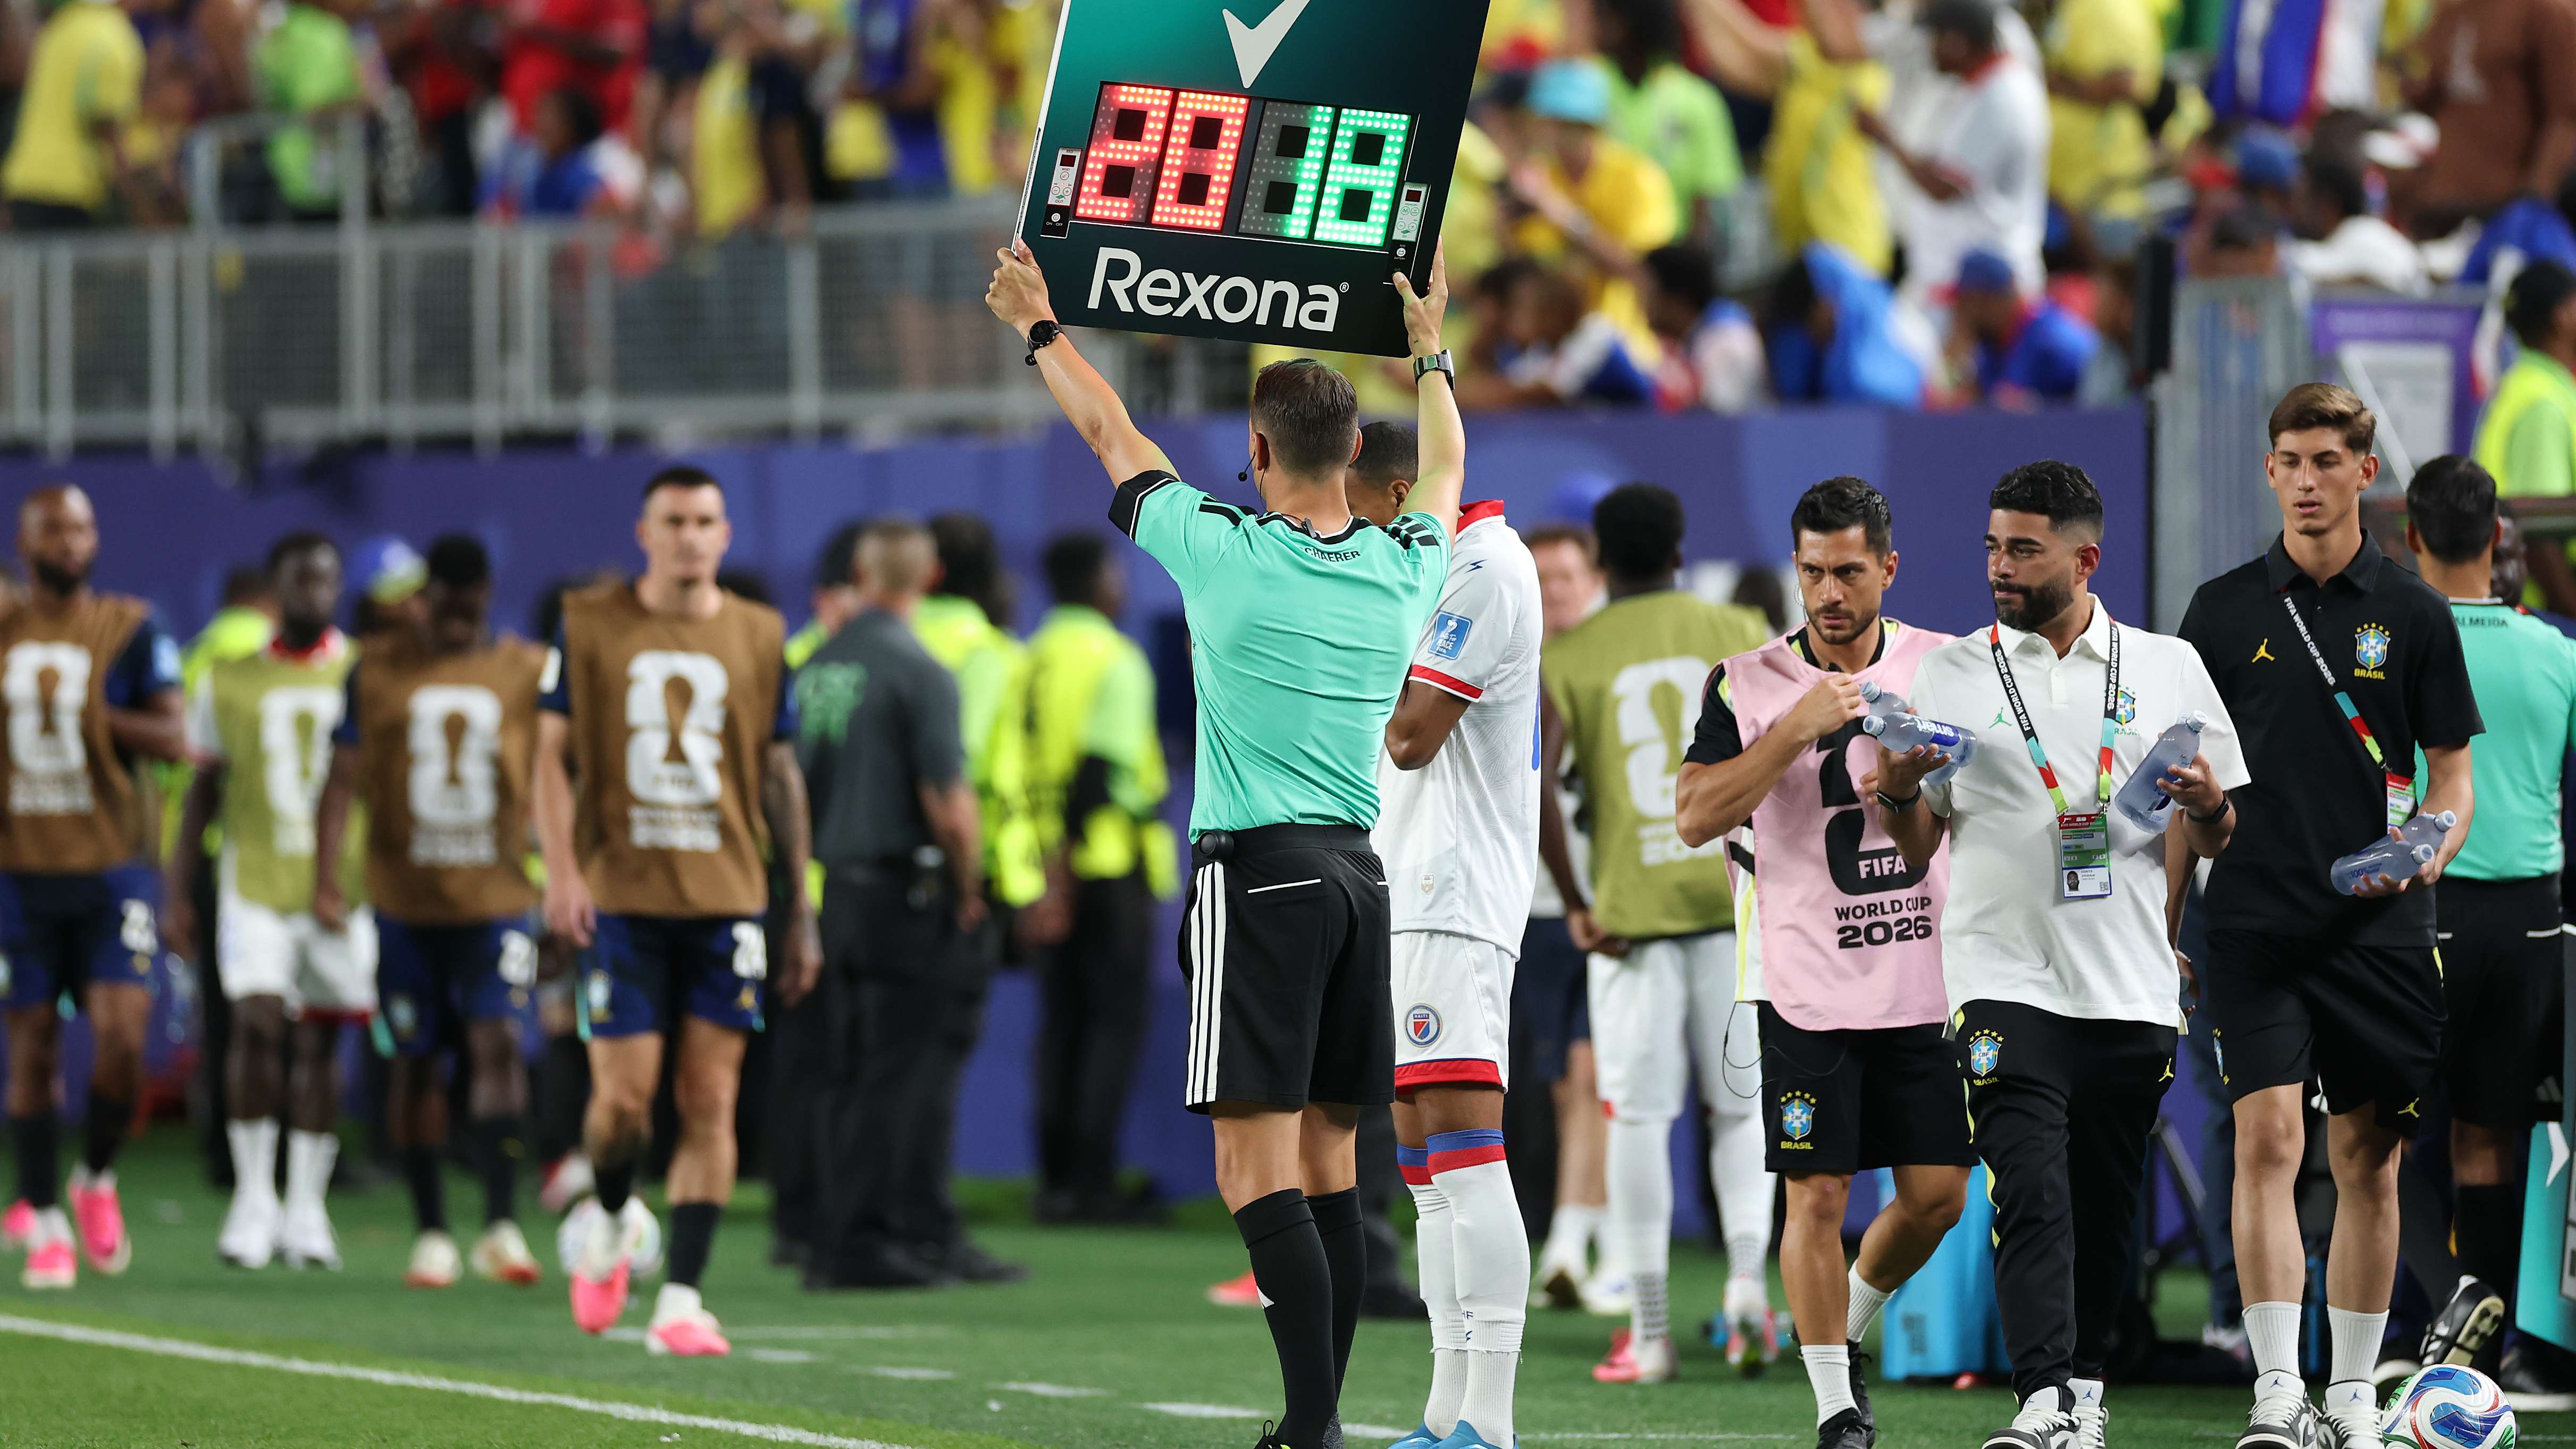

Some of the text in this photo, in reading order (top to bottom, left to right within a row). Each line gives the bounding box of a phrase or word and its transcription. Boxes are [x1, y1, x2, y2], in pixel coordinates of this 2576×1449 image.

[1076, 85, 1411, 246] 20 18
[1299, 547, 1361, 562] CHAERER
[2284, 596, 2336, 686] FIFA WORLD CUP 2026
[2354, 668, 2386, 680] BRASIL
[1995, 648, 2031, 732] FIFA WORLD CUP 2026
[2107, 684, 2116, 711] 2026
[1858, 855, 1907, 880] FIFA
[1834, 897, 1932, 921] WORLD CUP
[1837, 915, 1933, 950] 2026
[1973, 1077, 2000, 1086] BRASIL
[1781, 1141, 1814, 1150] BRASIL
